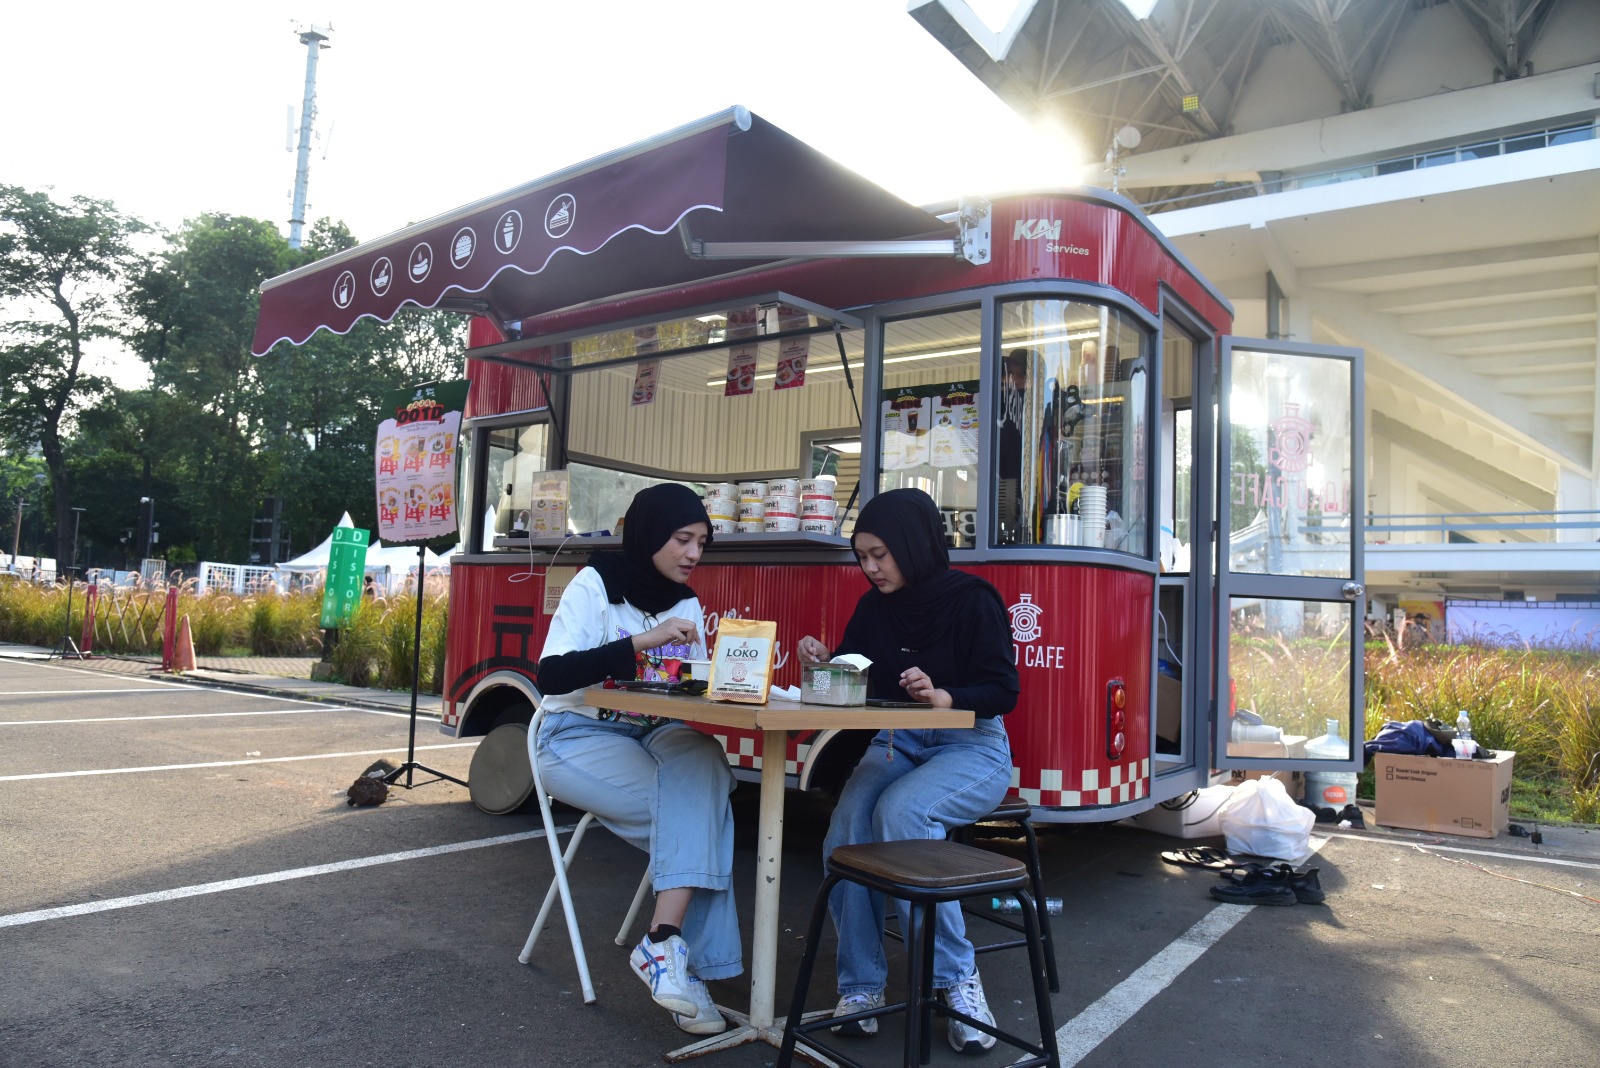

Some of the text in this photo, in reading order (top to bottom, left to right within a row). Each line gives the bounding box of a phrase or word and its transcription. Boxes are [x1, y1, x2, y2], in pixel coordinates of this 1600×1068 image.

[1013, 219, 1062, 241] KAI
[1045, 242, 1090, 256] Services
[726, 648, 759, 658] LOKO
[1025, 645, 1065, 669] CAFE
